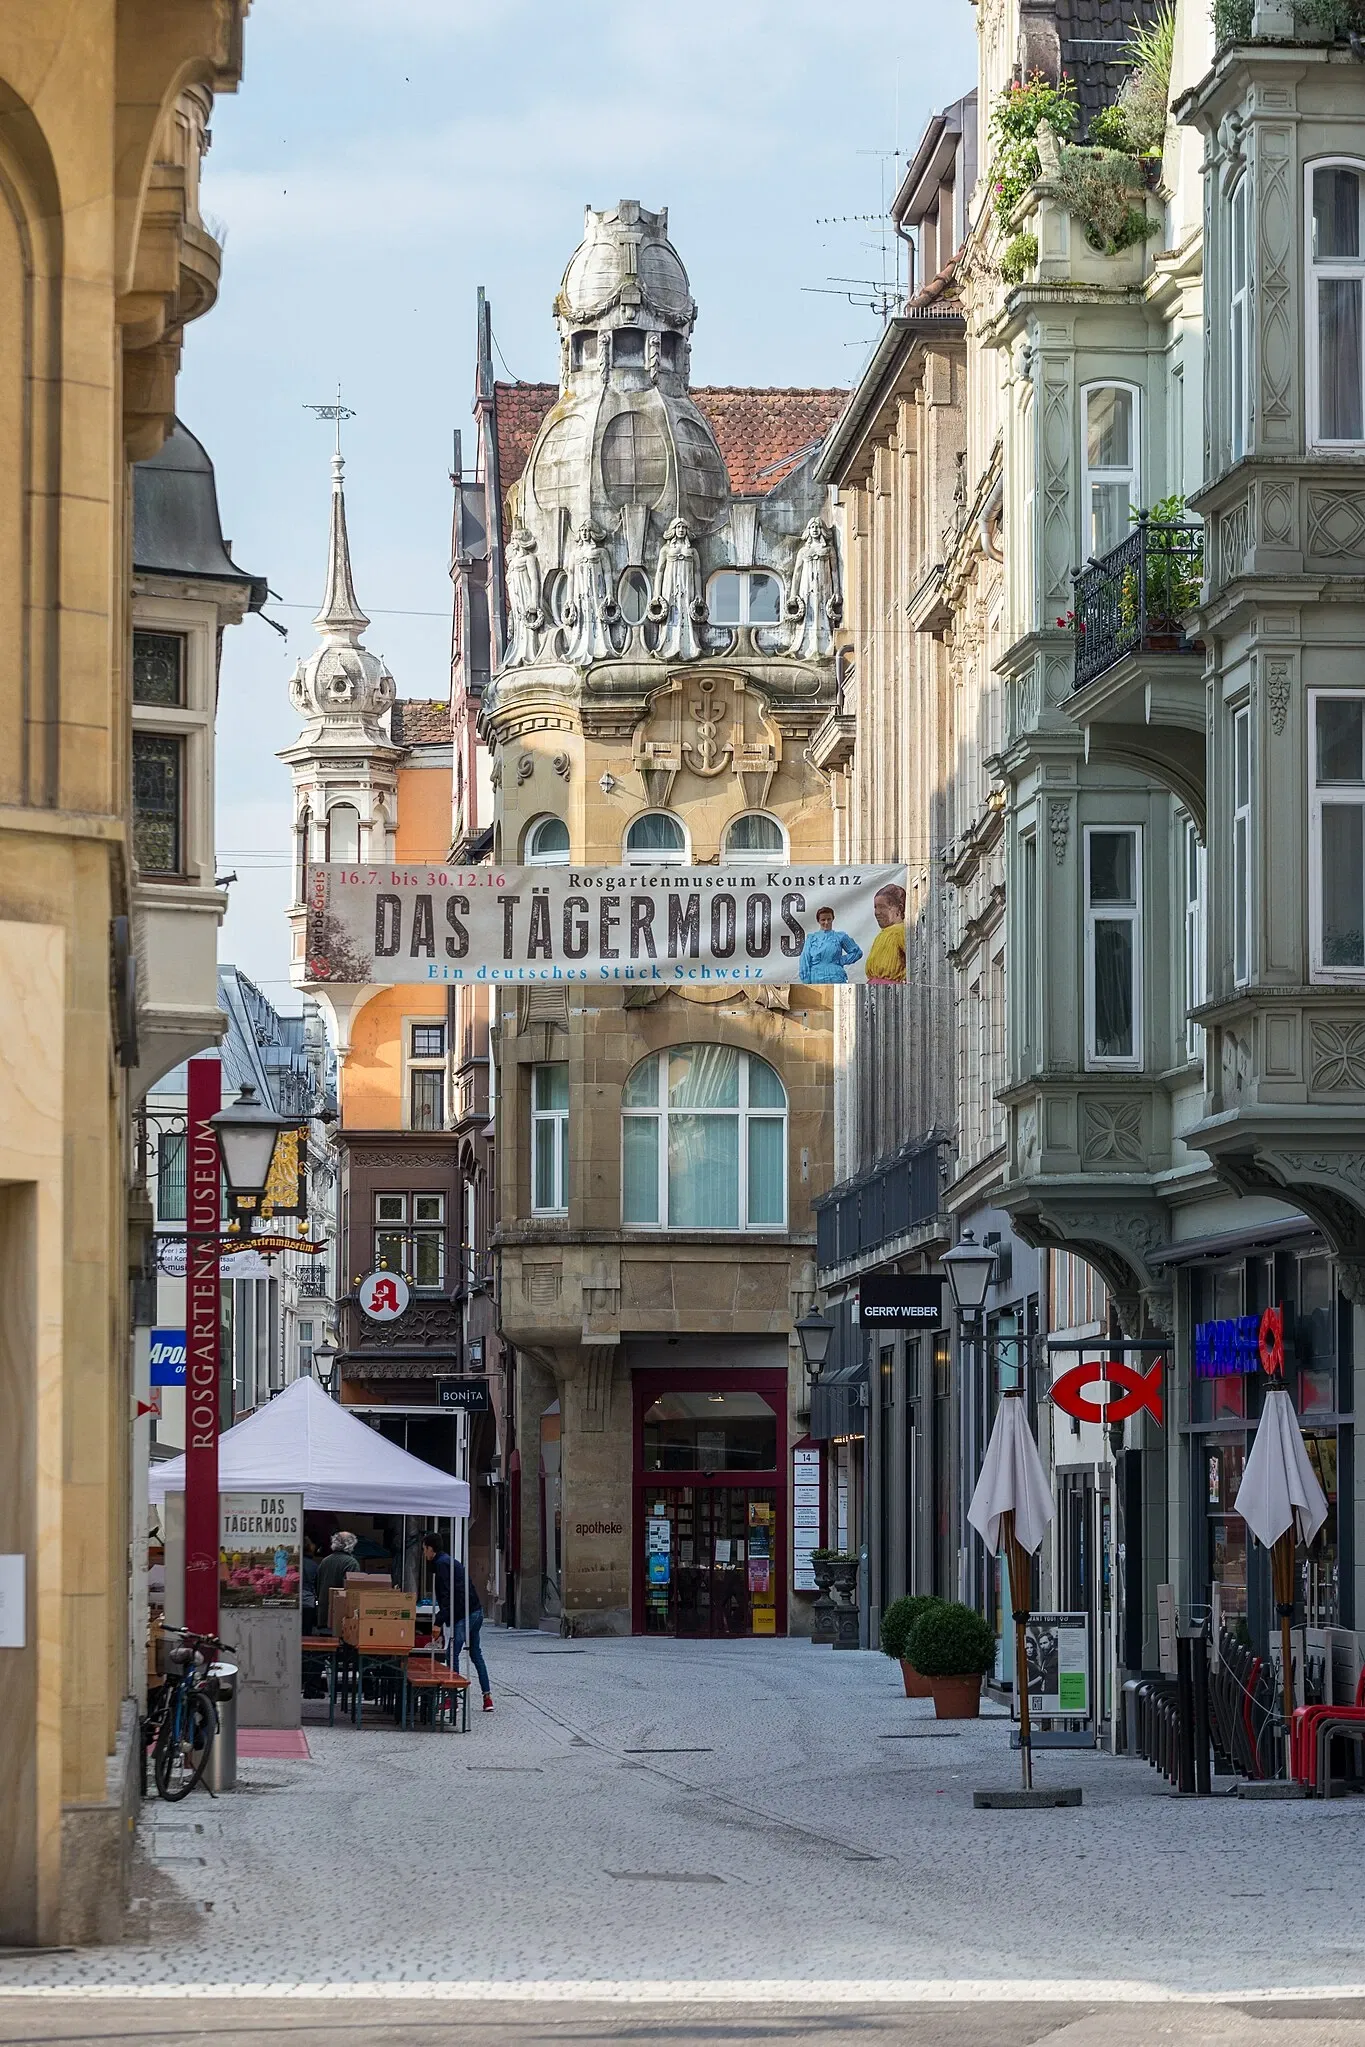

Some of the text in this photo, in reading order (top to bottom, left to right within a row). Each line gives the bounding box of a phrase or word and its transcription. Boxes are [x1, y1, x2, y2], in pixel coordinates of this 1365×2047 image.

[340, 871, 506, 887] 16.7. bis 30.12.16
[568, 873, 862, 891] Rosgartenmuseum Konstanz
[375, 893, 470, 958] DAS
[497, 887, 806, 959] TÄGERMOOS
[428, 964, 763, 979] Ein deutsches Stück Schweiz
[864, 1306, 938, 1317] GERRY WEBER
[149, 1343, 186, 1364] APOL
[175, 1366, 187, 1374] OP
[803, 1453, 811, 1462] 14
[261, 1499, 284, 1514] DAS
[224, 1514, 297, 1533] TÄGERMOOS
[575, 1521, 623, 1536] apotheke
